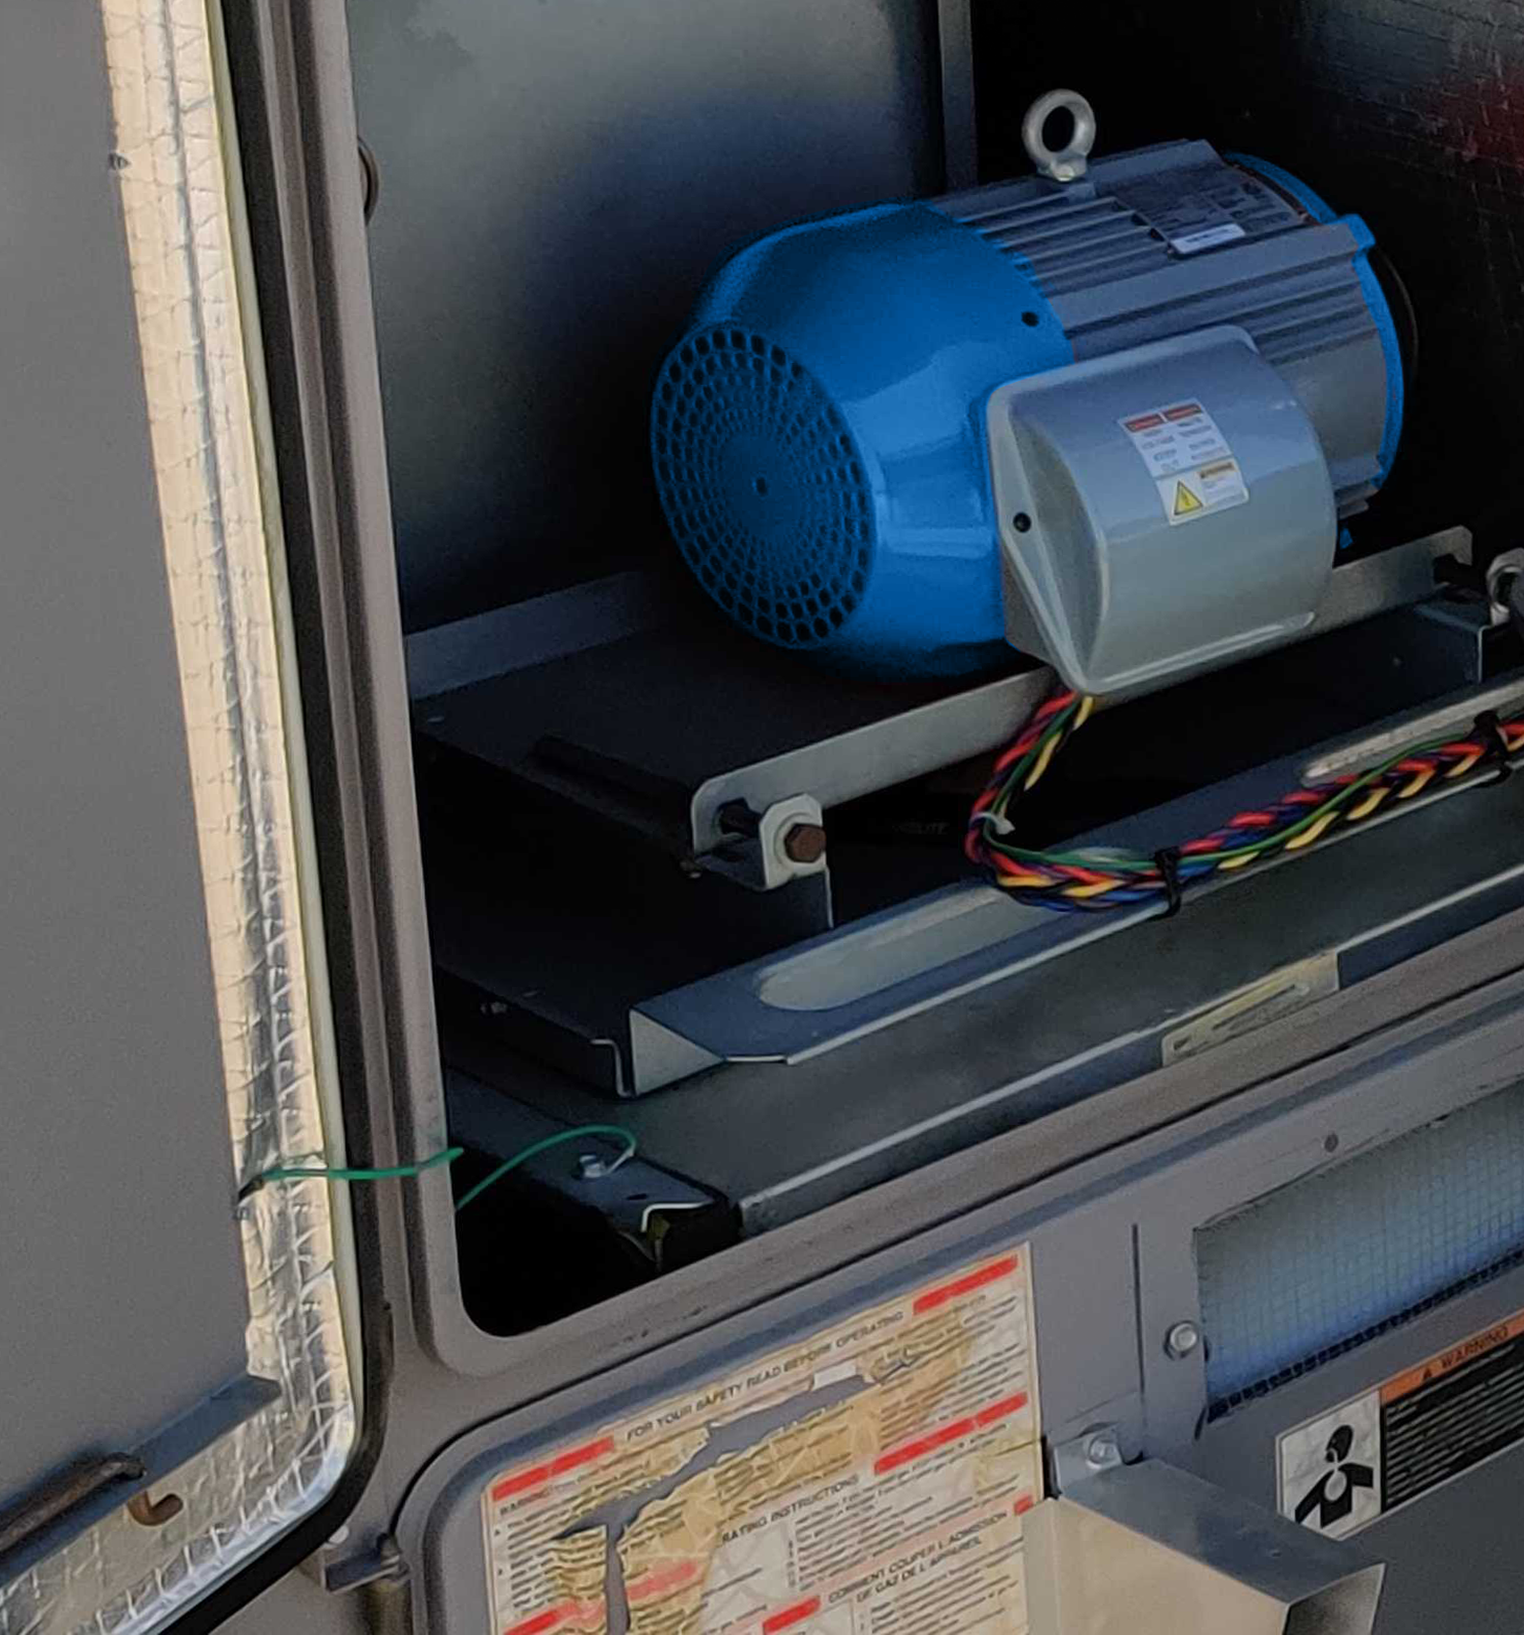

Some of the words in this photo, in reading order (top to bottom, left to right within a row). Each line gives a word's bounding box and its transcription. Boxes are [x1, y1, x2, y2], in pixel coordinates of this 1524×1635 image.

[626, 1421, 655, 1442] FOR
[656, 1404, 693, 1427] YOUR
[696, 1383, 743, 1412] SAFETY
[747, 1366, 782, 1388] READ
[836, 1311, 904, 1349] OPERATING
[721, 1516, 768, 1544] RATING
[771, 1473, 859, 1522] INSTRUCTIONS
